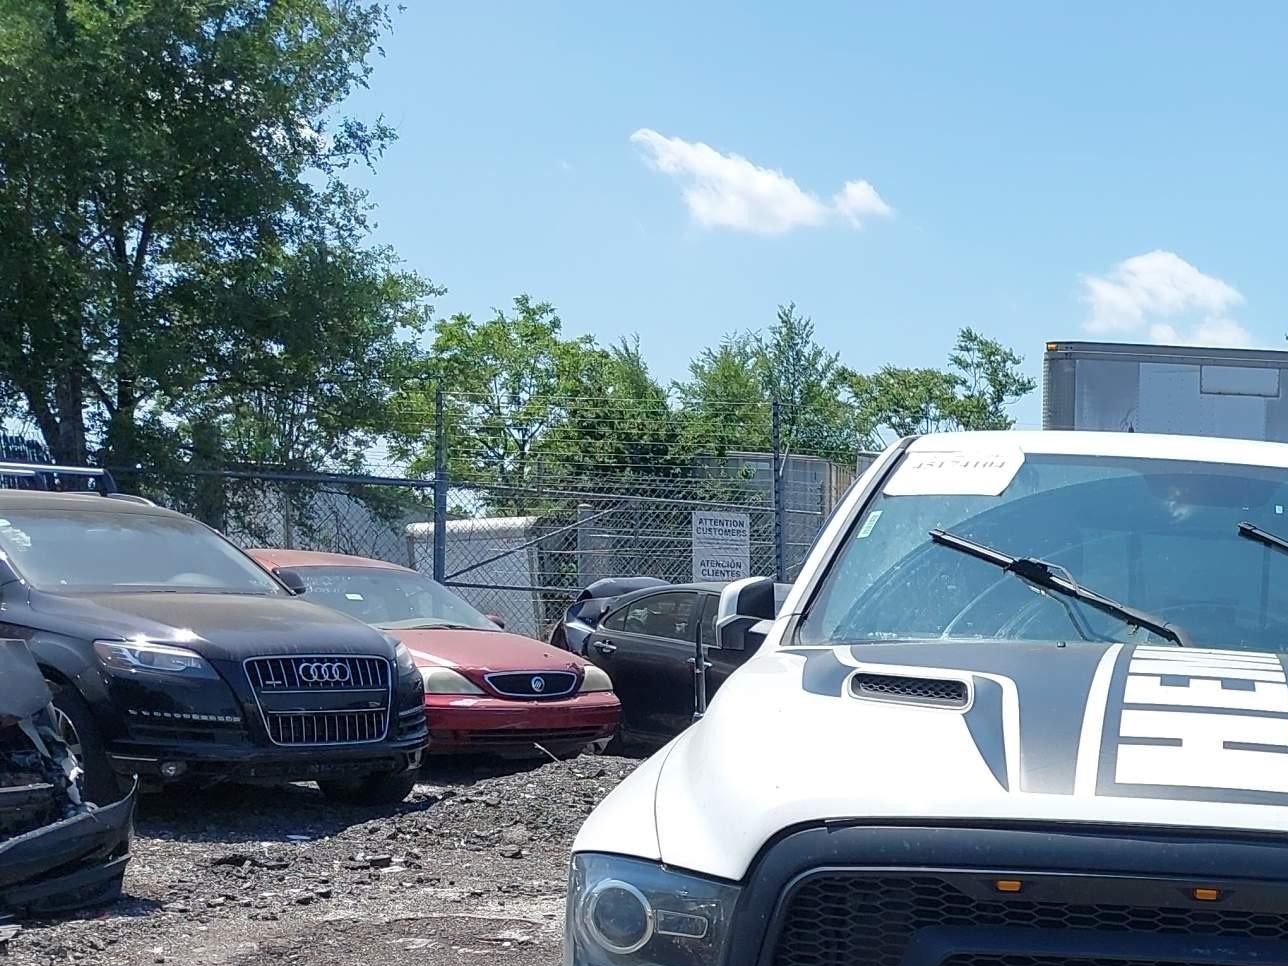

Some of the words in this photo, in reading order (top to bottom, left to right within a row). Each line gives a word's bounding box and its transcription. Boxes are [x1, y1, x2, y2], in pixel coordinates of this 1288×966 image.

[698, 518, 745, 528] ATTENTION
[696, 527, 748, 537] CUSTOMERS
[701, 569, 741, 577] CLIENTES
